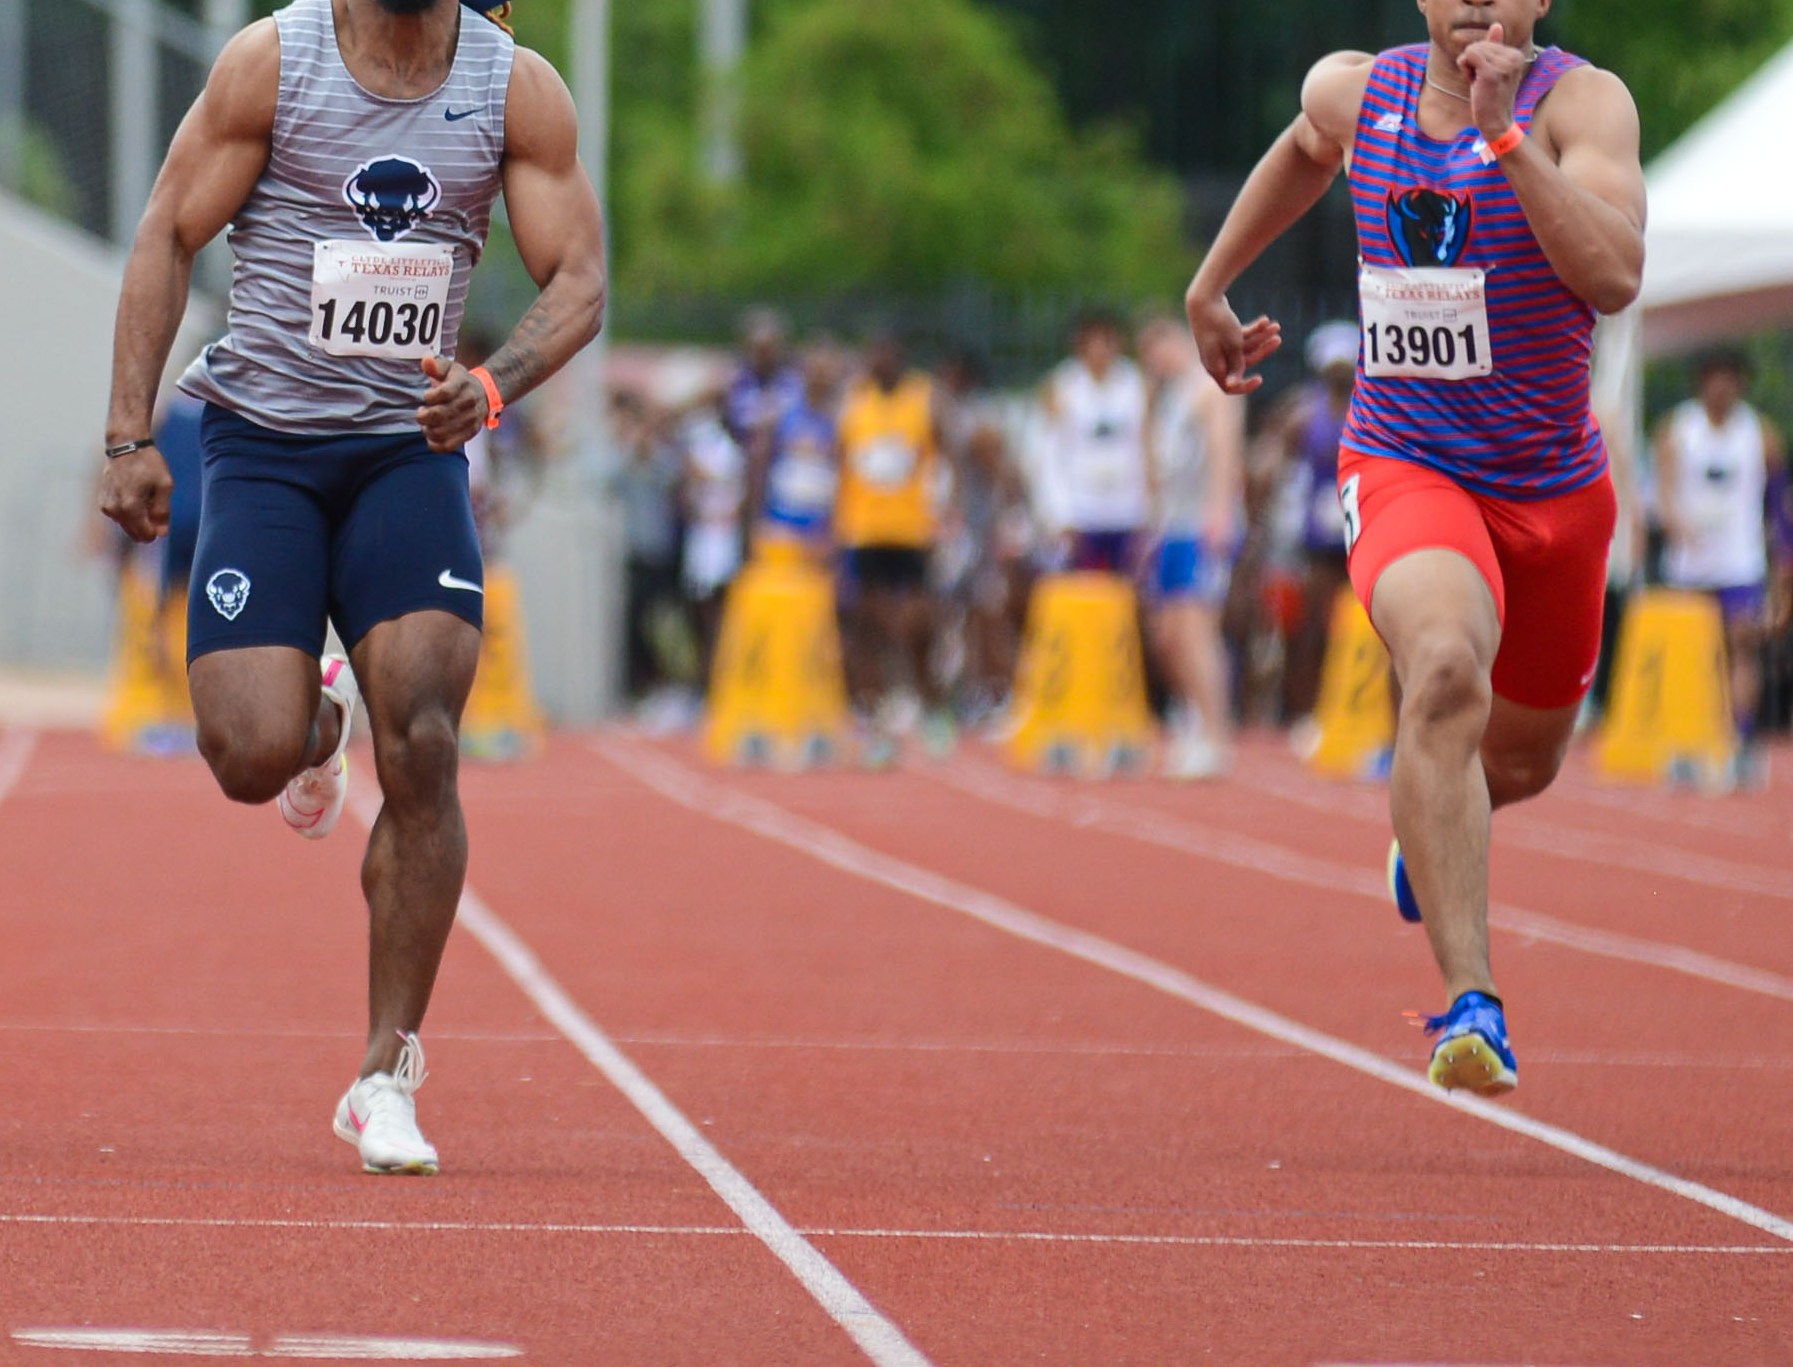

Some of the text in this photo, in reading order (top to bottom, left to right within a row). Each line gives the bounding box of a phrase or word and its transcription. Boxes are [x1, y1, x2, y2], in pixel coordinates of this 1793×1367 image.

[351, 262, 451, 278] TEXAS RELAYS
[373, 285, 413, 297] TRUIST
[317, 298, 441, 346] 14030
[1367, 321, 1478, 367] 13901
